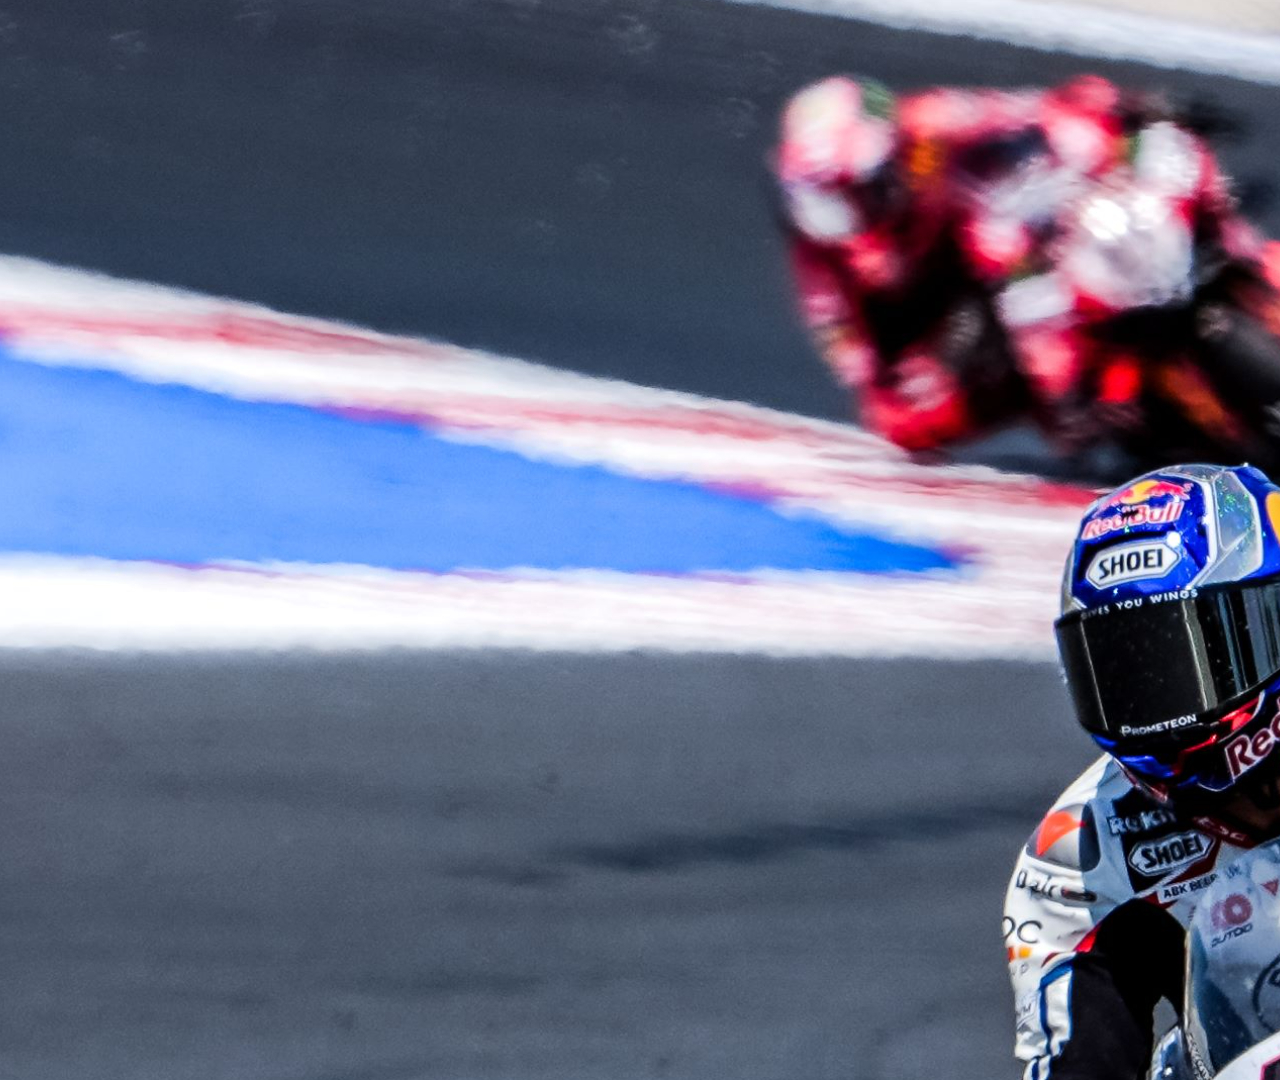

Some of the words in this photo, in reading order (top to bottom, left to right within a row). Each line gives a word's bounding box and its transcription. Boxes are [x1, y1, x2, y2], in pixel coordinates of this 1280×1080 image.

[1098, 549, 1163, 580] SHOEI
[1116, 598, 1143, 611] YOU
[1149, 588, 1199, 604] WINGS
[1121, 713, 1197, 737] PROMETEON
[1140, 834, 1204, 869] SHOEI
[1163, 884, 1188, 899] ABK
